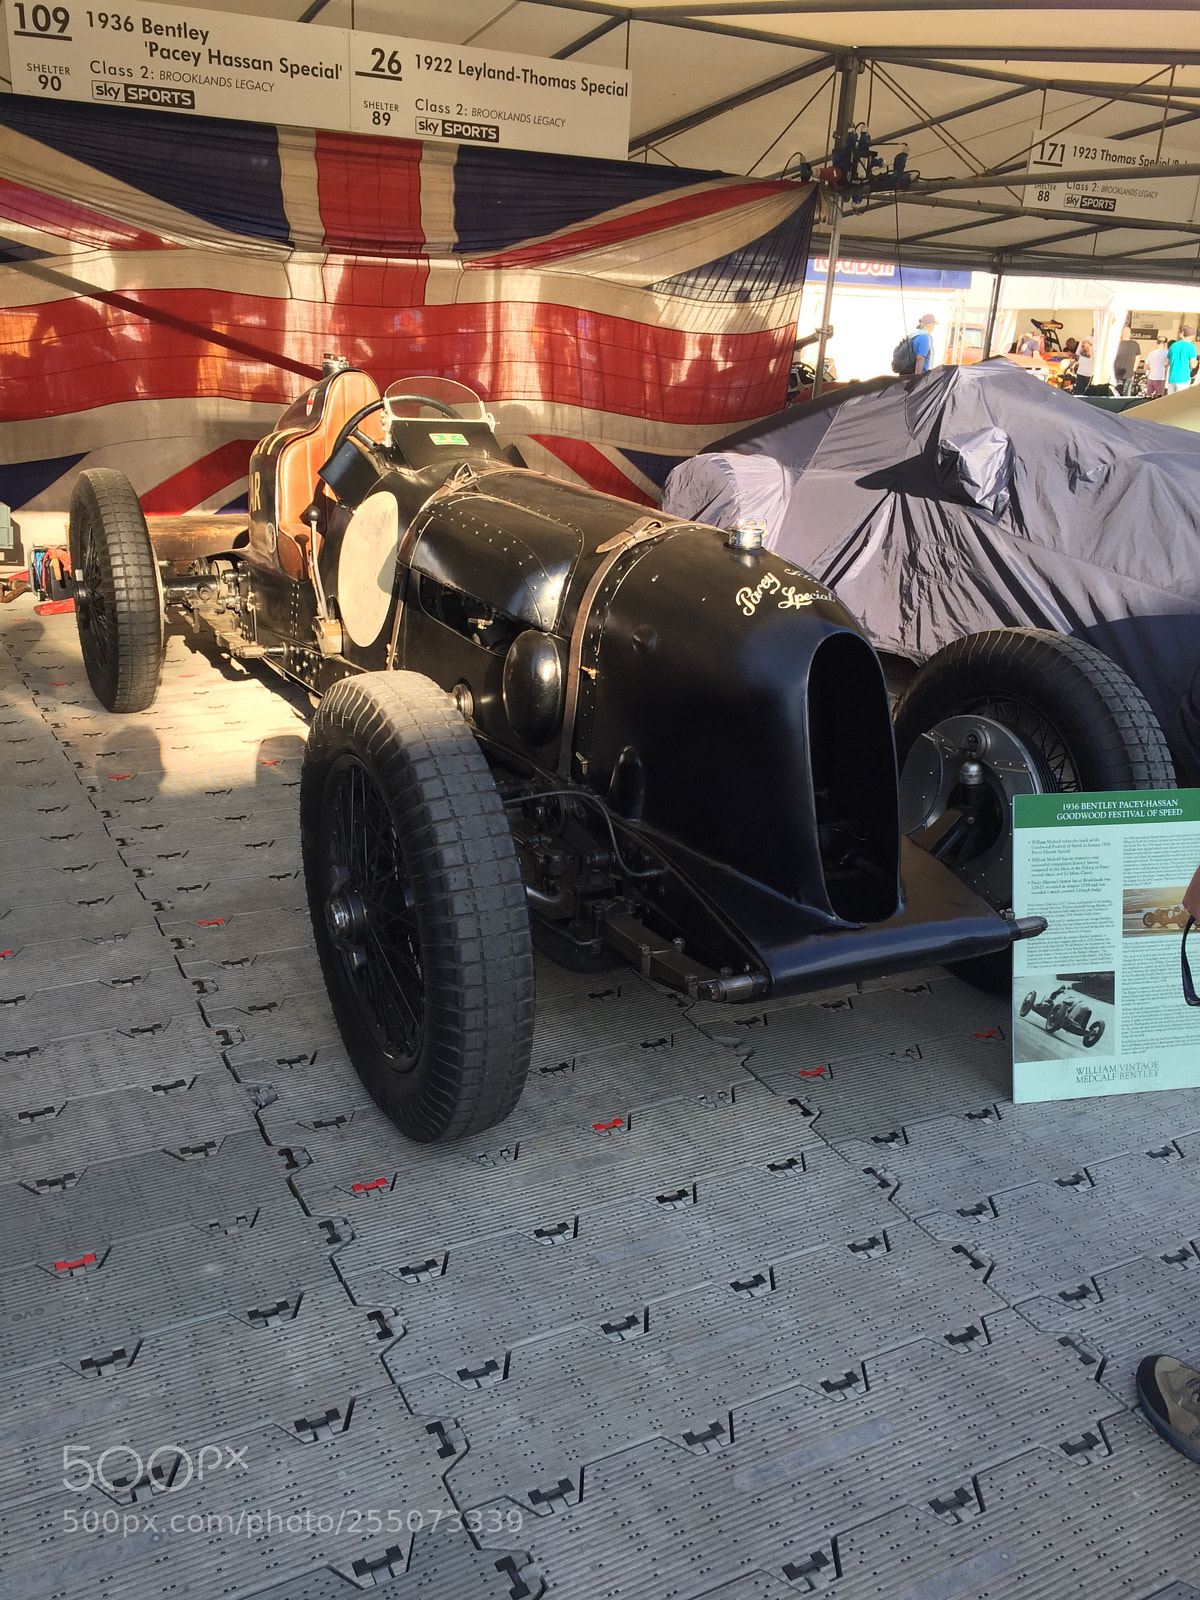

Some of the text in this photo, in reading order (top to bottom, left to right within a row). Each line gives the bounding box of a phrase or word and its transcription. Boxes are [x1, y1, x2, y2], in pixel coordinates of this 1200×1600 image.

[14, 2, 70, 34] 109
[86, 11, 210, 45] 1936 Bentley
[27, 63, 71, 76] SHELTER
[144, 40, 343, 80] 'Pacey Hassan Special'
[371, 48, 402, 75] 26
[38, 74, 62, 92] 90
[90, 60, 274, 93] Class 2: BROOKLANDS LEGACY
[415, 54, 628, 97] 1922 Leyland-Thomas Special
[95, 83, 192, 106] sky SPORTS
[363, 100, 400, 112] SHELTER
[415, 98, 566, 128] Class 2: BROOKLANDS LEGACY
[372, 111, 391, 127] 89
[418, 119, 497, 139] sky SPORTS
[1038, 141, 1066, 163] 171
[1073, 145, 1171, 167] 1923 Thomas Speial
[1037, 190, 1050, 202] 88
[1066, 182, 1089, 191] Class
[1101, 185, 1138, 197] BROOKLANDS
[1138, 189, 1159, 199] LEGACY
[1066, 195, 1115, 211] sky SPORTS
[736, 572, 781, 616] Pacey
[1056, 812, 1107, 821] GOODWOOD
[1108, 810, 1145, 819] FESTIVAL
[1158, 808, 1183, 816] SPEED
[1062, 799, 1179, 811] 1936 BENTLEY PACEY-HASSAN
[1076, 1061, 1159, 1075] WILLIAM VINTAGE
[1076, 1070, 1159, 1084] MEDCALF BENTLEY
